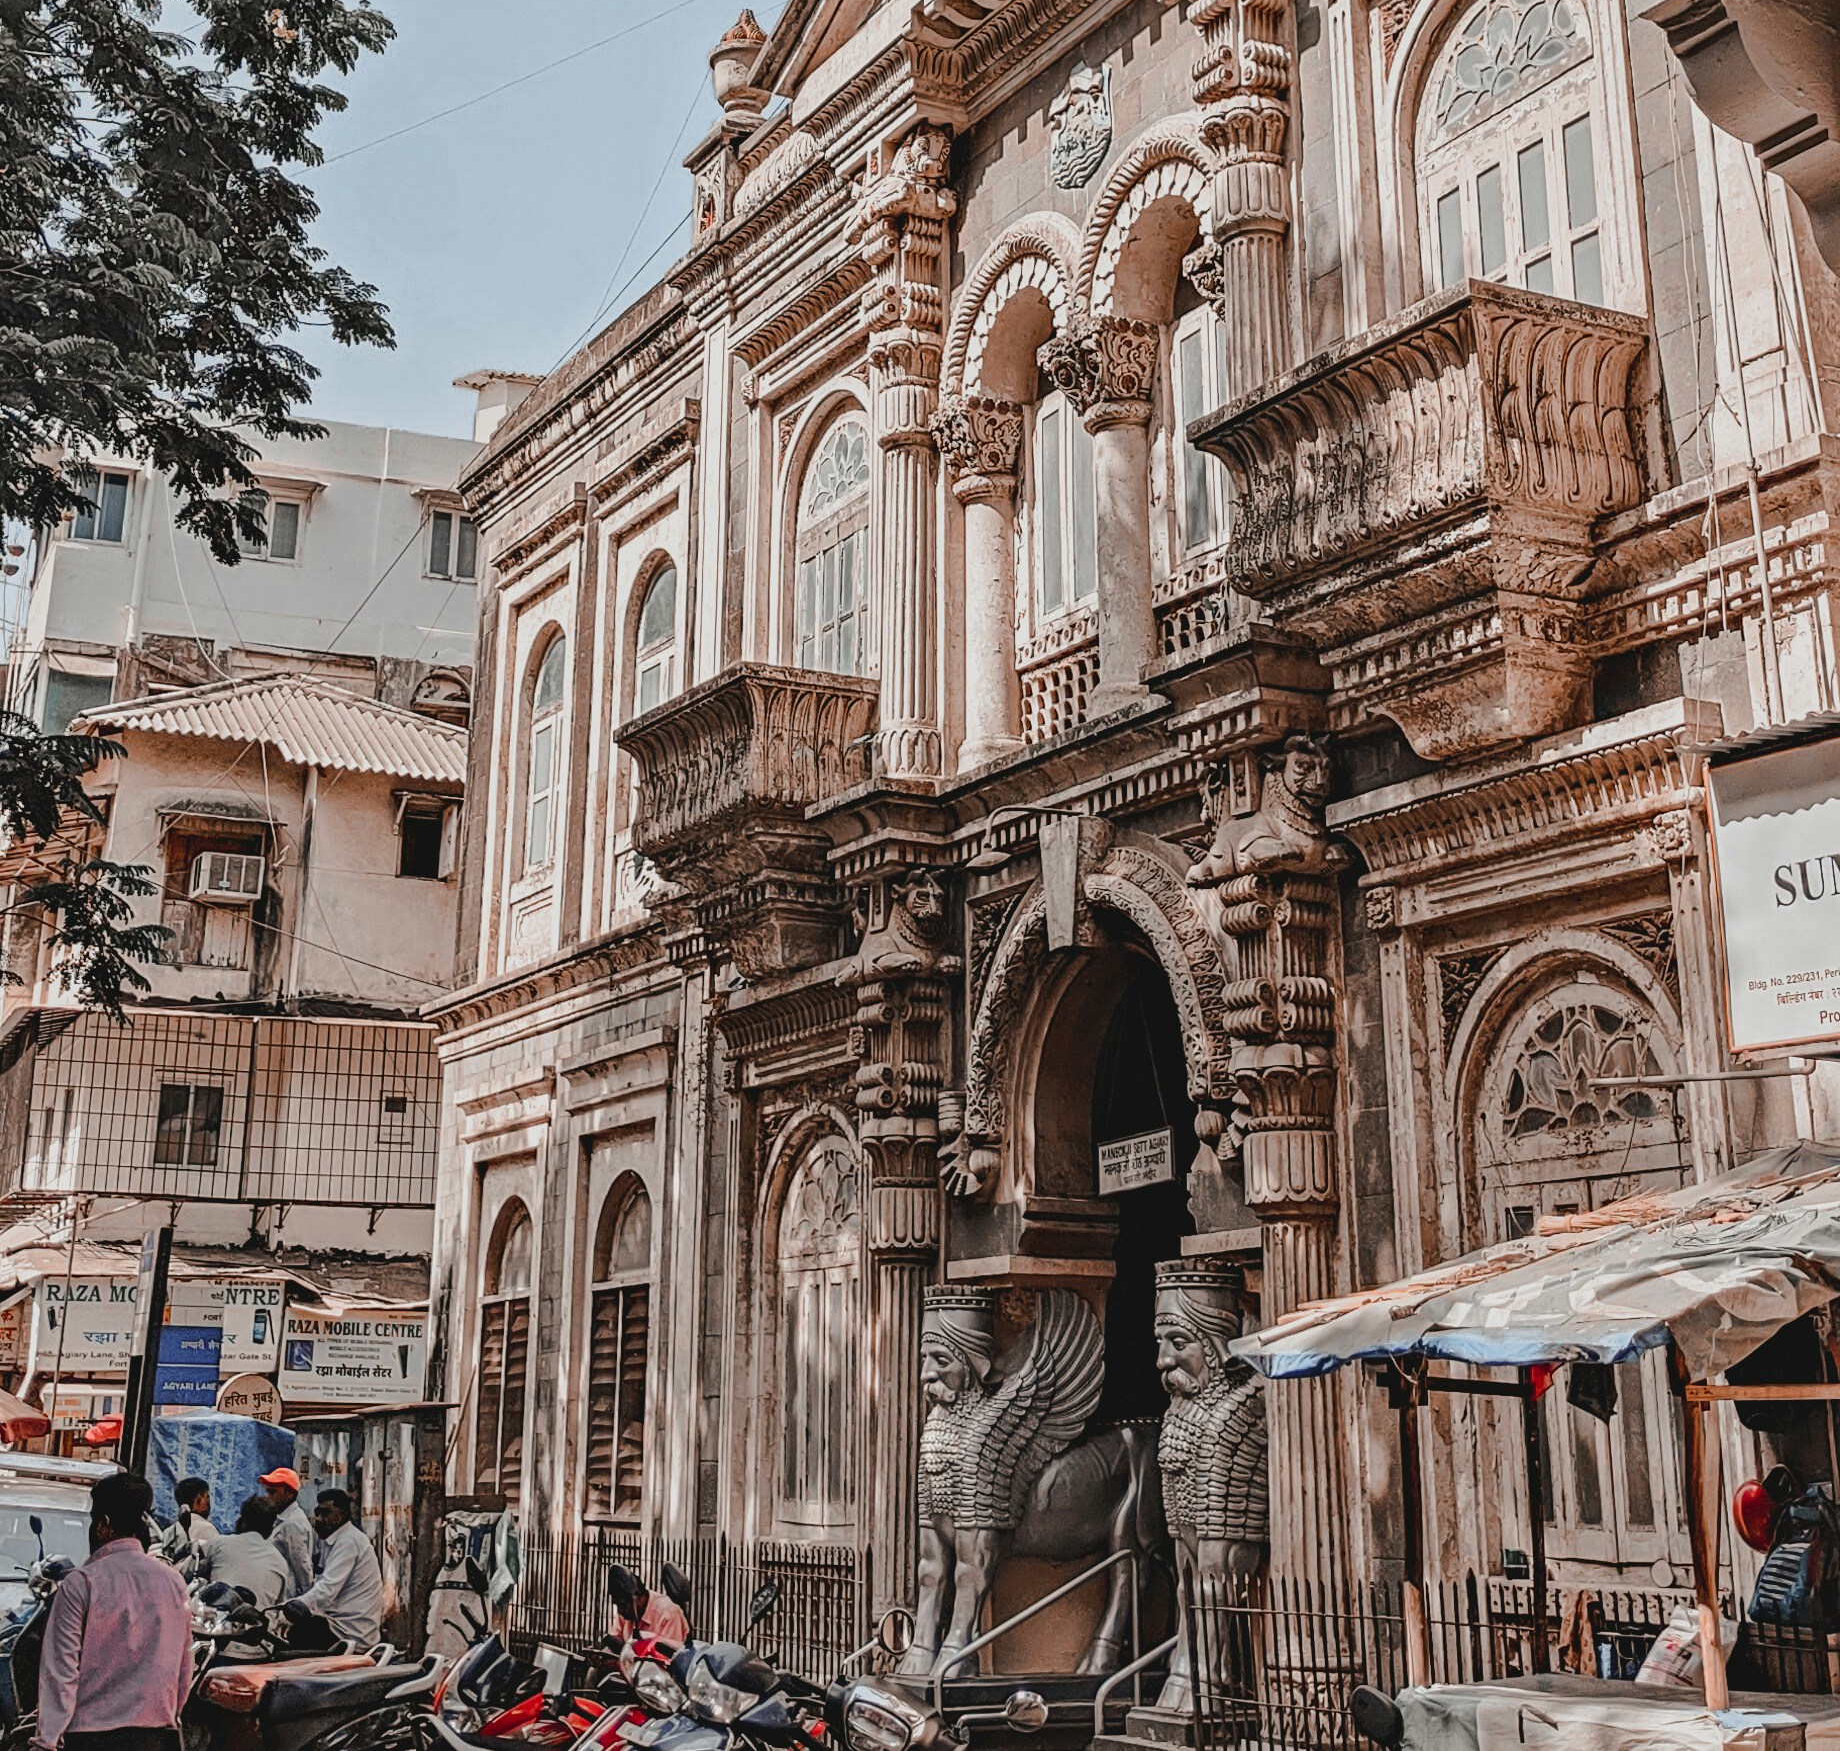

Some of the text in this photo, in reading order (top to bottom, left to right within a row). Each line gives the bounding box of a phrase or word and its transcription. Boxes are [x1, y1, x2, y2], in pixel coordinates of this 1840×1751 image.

[1748, 980, 1767, 991] Bldg
[1770, 977, 1785, 987] No.
[46, 1284, 102, 1302] RAZA
[224, 1288, 281, 1305] NTRE
[287, 1319, 424, 1339] RAZA MOBILE CENTRE
[224, 1391, 248, 1408] हरित
